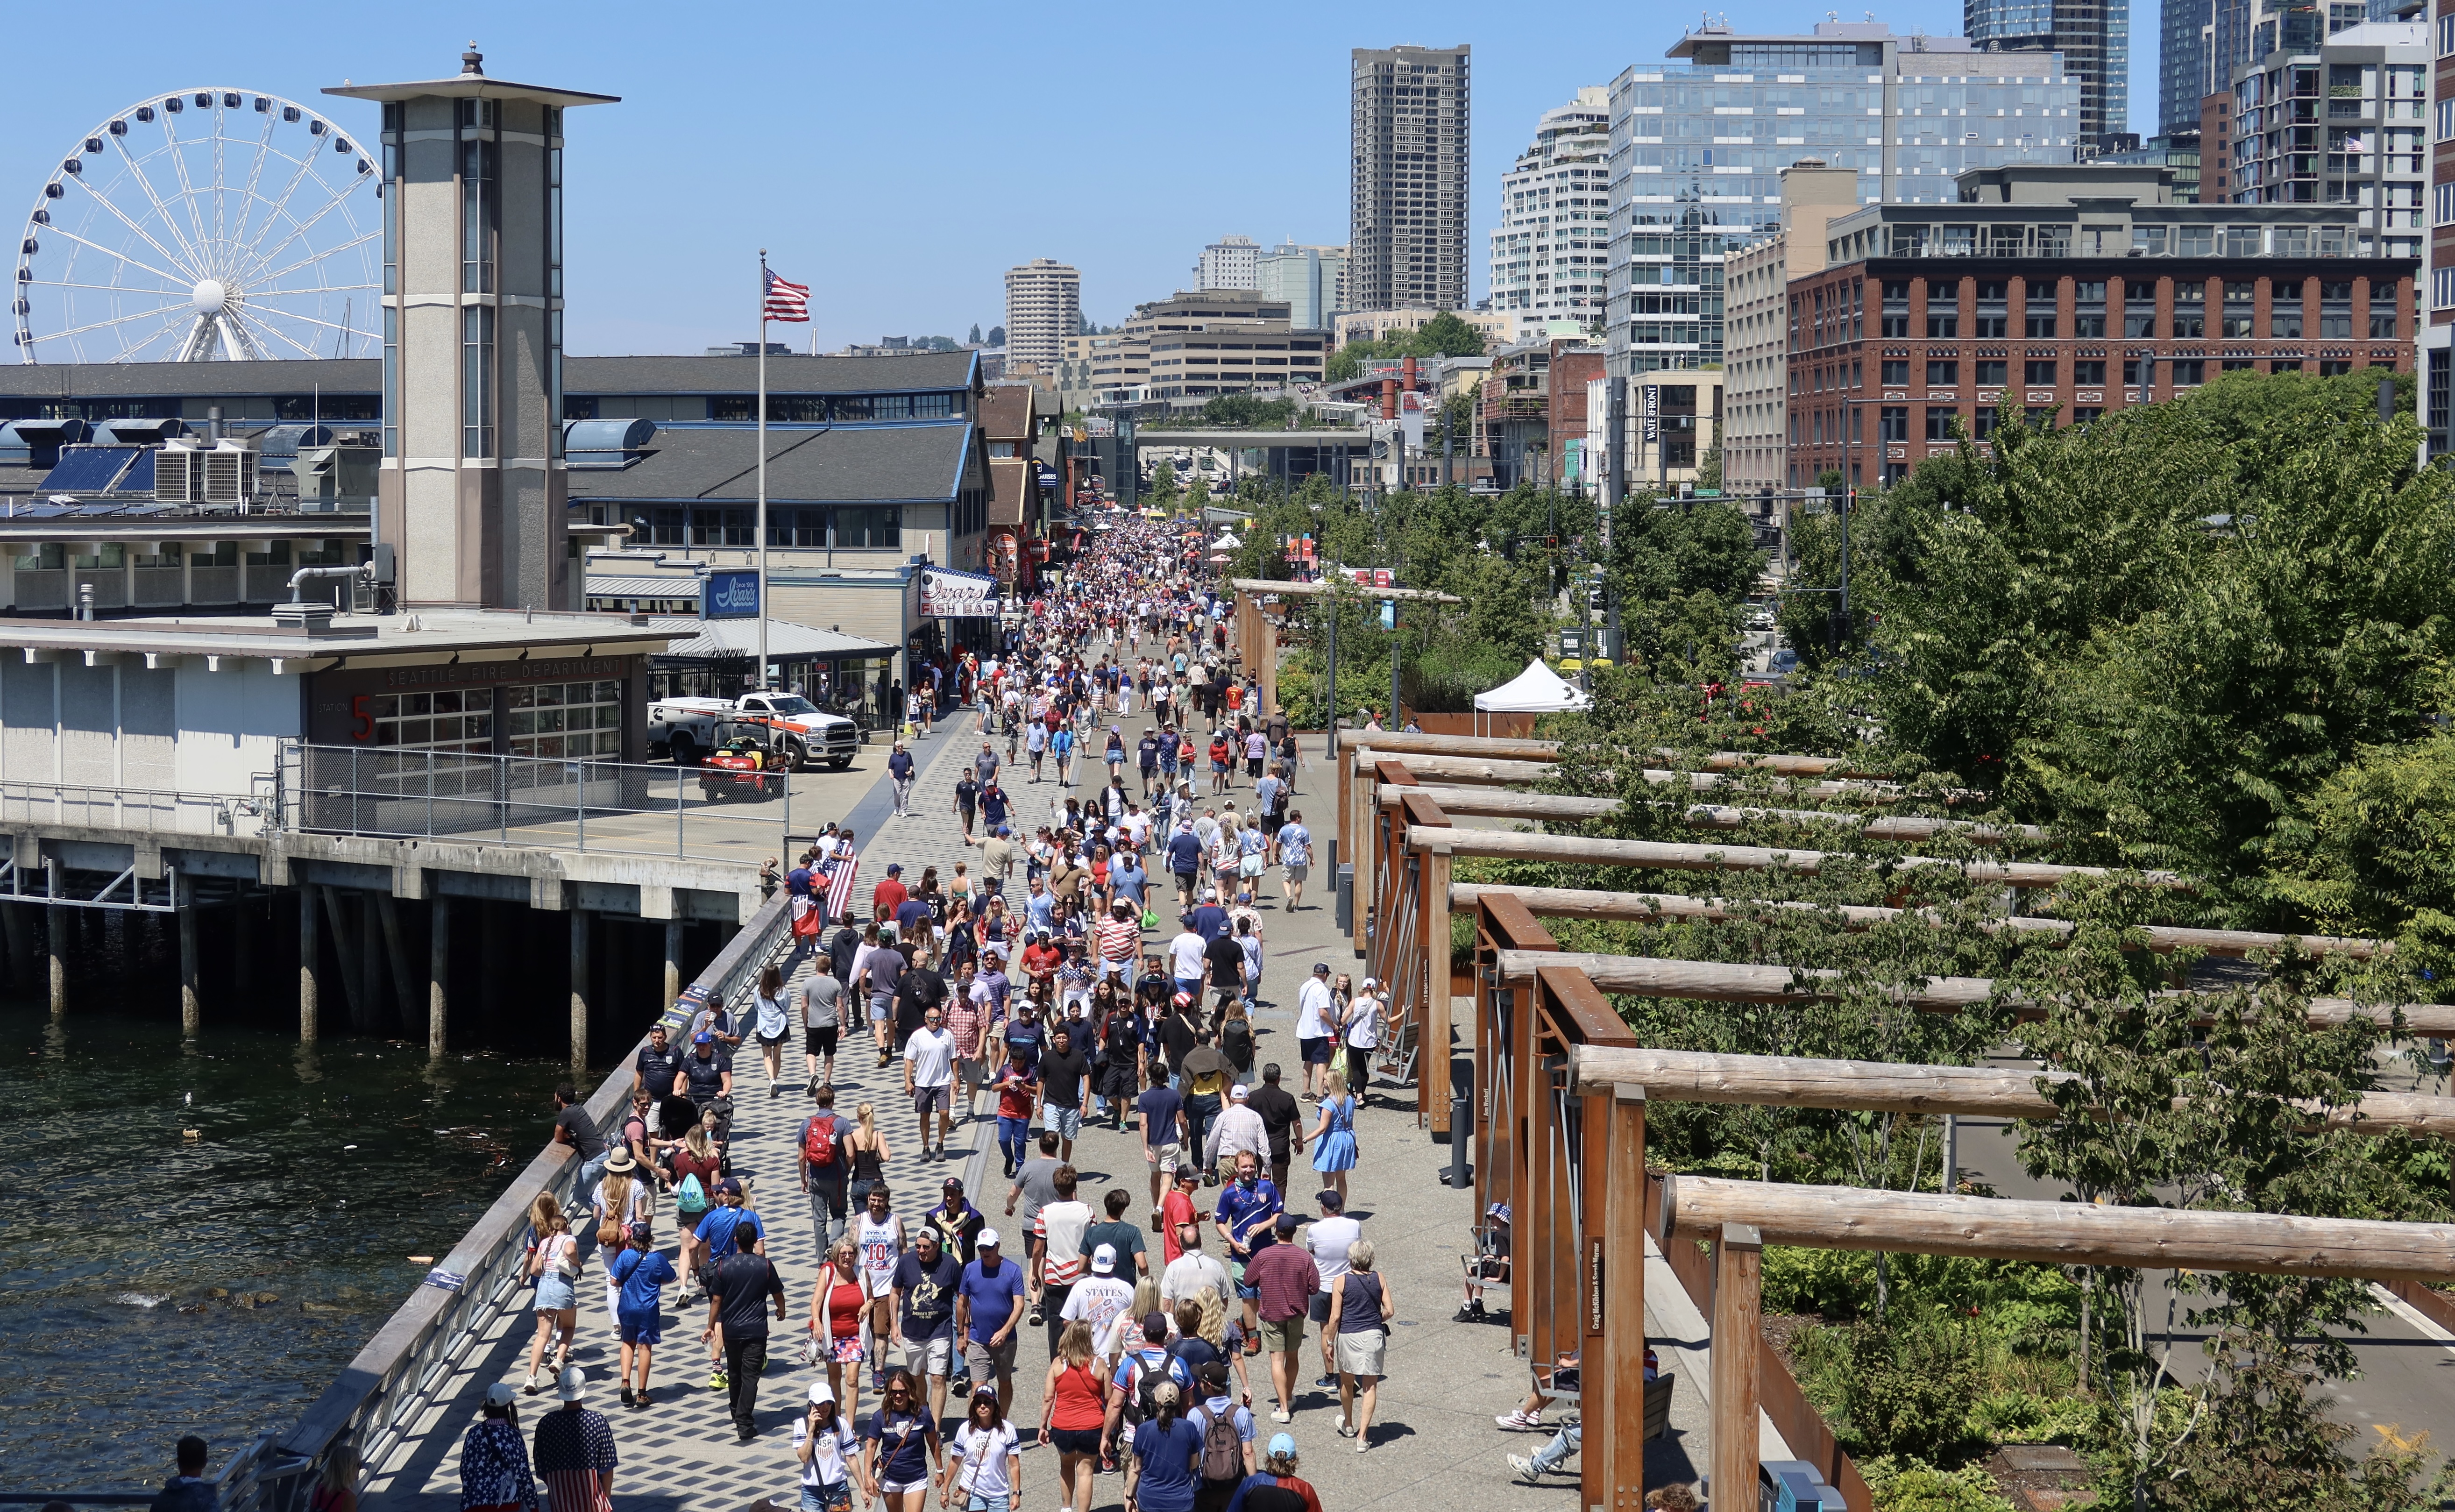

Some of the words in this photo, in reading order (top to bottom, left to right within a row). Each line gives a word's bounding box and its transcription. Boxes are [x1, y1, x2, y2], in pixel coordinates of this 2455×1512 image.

[1647, 386, 1656, 440] WATERFRONT
[921, 603, 955, 615] FISH
[963, 603, 995, 614] BAR
[389, 669, 456, 686] SEATTLE
[472, 666, 507, 680] FIRE
[522, 659, 620, 678] DEPARTMENT
[1231, 692, 1236, 702] 7
[319, 703, 348, 713] STATION
[352, 696, 373, 740] 5
[1225, 844, 1234, 855] 10
[866, 1230, 888, 1243] NBA
[868, 1243, 886, 1261] 10
[1086, 1288, 1122, 1297] STATES
[1592, 1314, 1601, 1329] Craig
[977, 1385, 993, 1394] USA
[976, 1442, 990, 1450] USA
